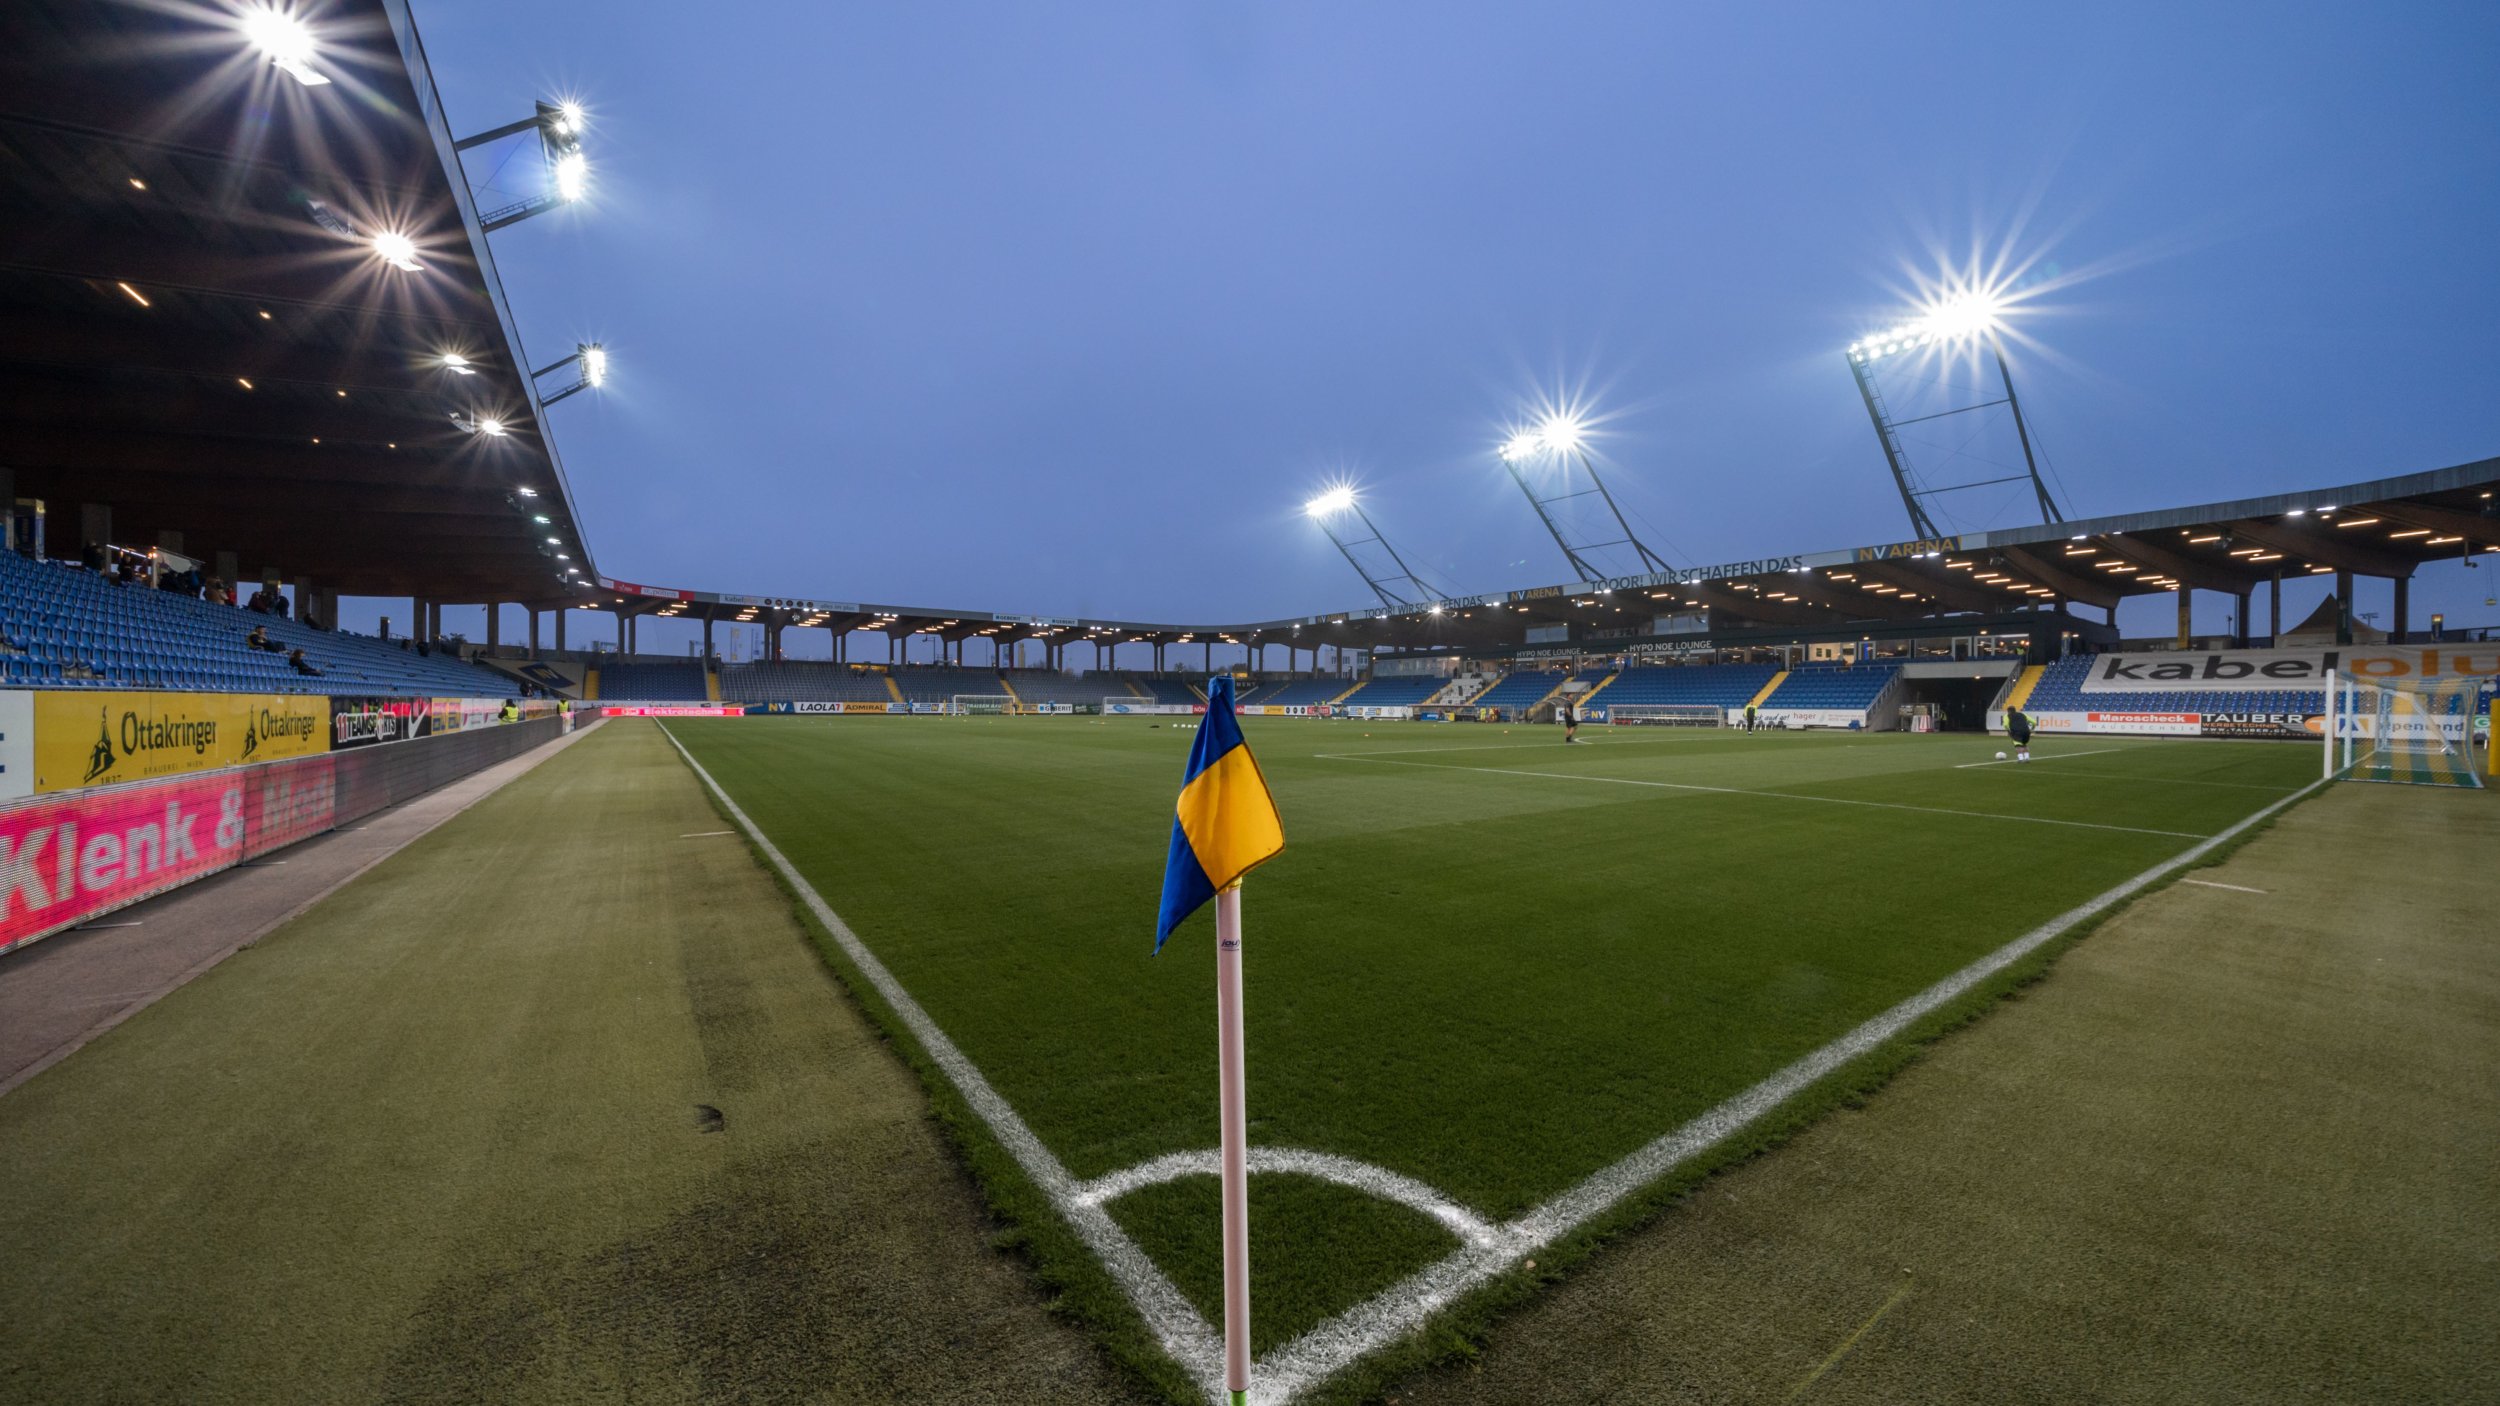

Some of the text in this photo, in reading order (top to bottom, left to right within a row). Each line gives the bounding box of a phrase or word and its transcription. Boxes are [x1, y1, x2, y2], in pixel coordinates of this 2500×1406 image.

[1860, 538, 1954, 561] NV ARENA
[1590, 576, 1643, 593] TOOOR!
[1649, 571, 1677, 586] WIR
[1680, 560, 1763, 583] SCHAFFEN
[1511, 587, 1560, 601] NV ARENA
[1629, 640, 1712, 652] HYPO NOE LOUNGE
[1516, 647, 1581, 658] HYPO NOE LOUNGE
[768, 703, 787, 712] NV
[1591, 711, 1605, 719] NV
[1793, 712, 1816, 720] hager
[2100, 714, 2186, 722] Maroscheck
[2202, 714, 2303, 723] TAUBER
[261, 708, 316, 742] Ottakringer
[121, 711, 216, 755] Ottakringer
[0, 802, 198, 922] Klenk
[215, 789, 244, 848] &
